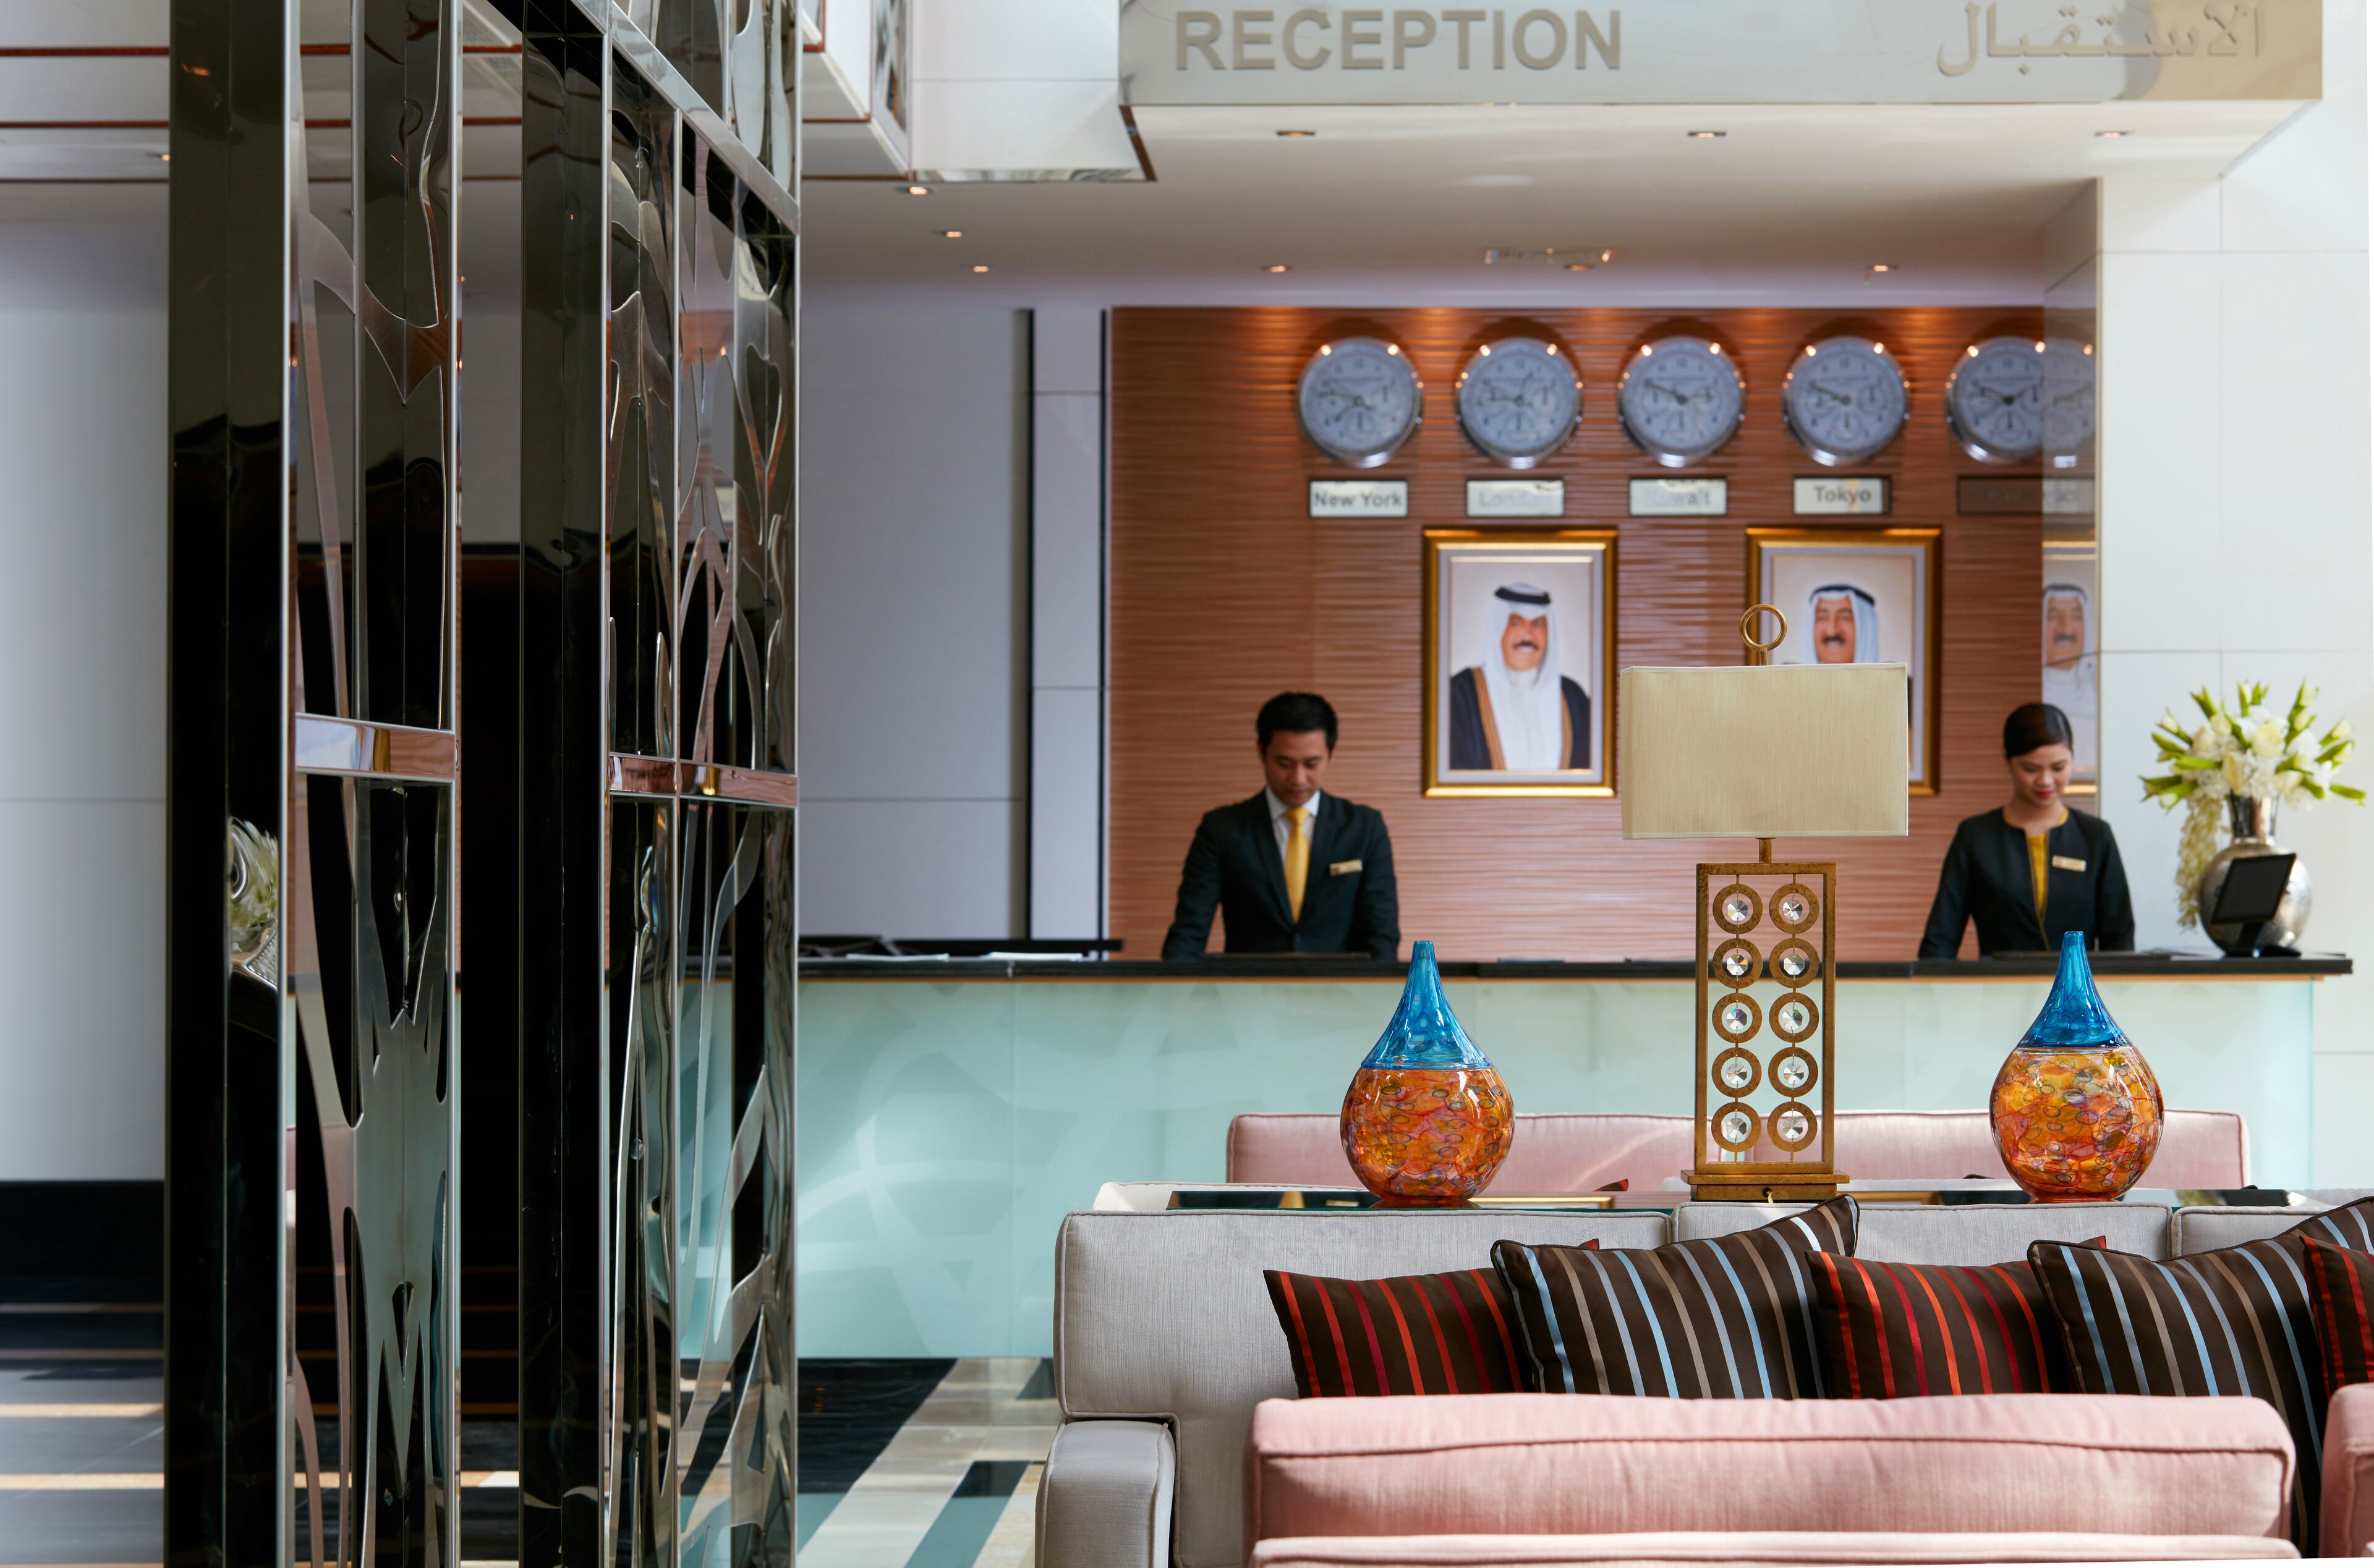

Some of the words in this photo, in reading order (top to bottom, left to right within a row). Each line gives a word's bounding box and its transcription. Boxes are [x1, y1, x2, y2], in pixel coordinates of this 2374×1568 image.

[1176, 9, 1620, 70] RECEPTION
[1937, 1, 2263, 78] الاستقبال
[1314, 491, 1356, 507] New
[1360, 490, 1403, 507] York
[1479, 489, 1554, 507] Lond
[1643, 488, 1711, 507] wait
[1814, 485, 1873, 506] Tokyo
